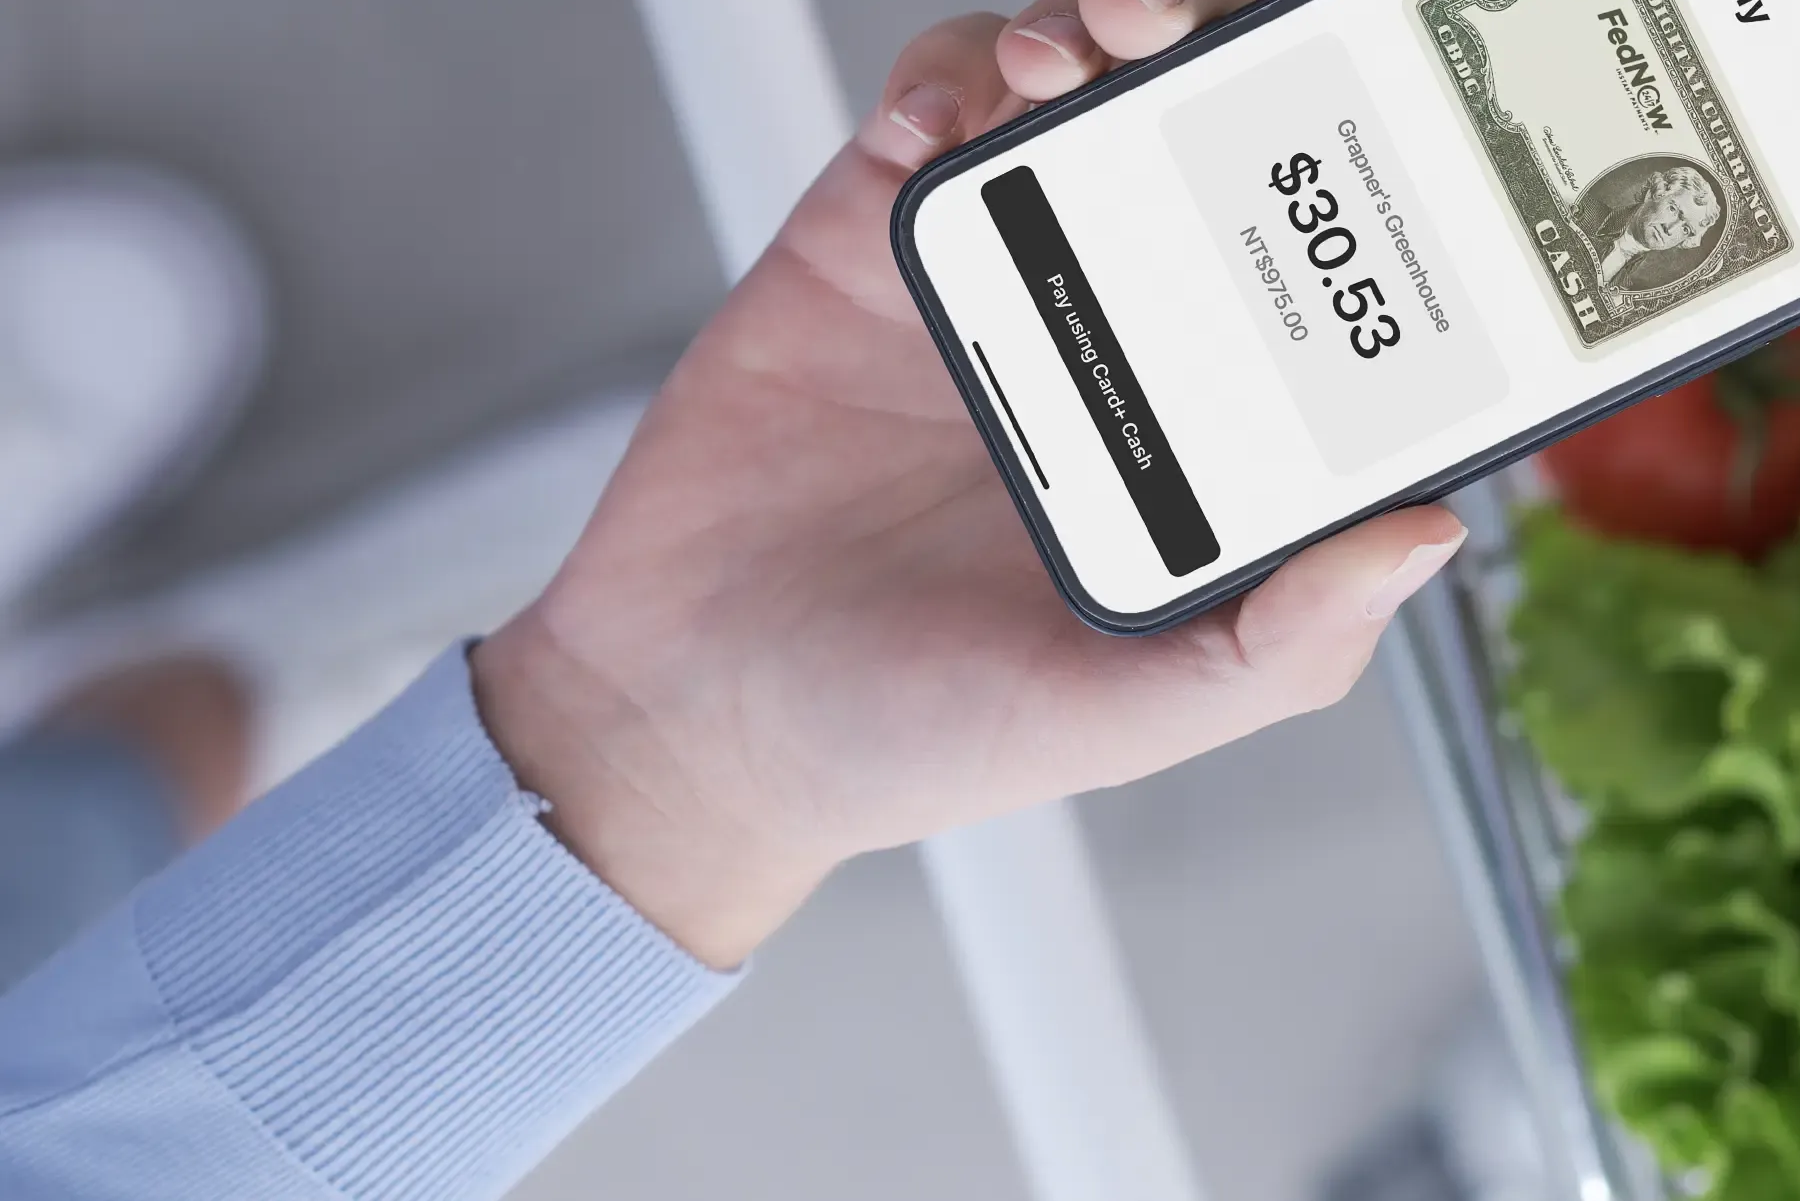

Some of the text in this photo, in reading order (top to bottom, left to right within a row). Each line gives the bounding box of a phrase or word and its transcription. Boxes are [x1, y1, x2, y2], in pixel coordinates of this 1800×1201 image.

[1438, 24, 1480, 96] CBDC
[1616, 68, 1650, 132] INSTANT PAYMENTS
[1337, 119, 1450, 333] Grapner's Greenhouse
[1701, 101, 1781, 244] CURRENCY
[1239, 225, 1308, 341] NT$975.00
[1268, 152, 1401, 359] $30.53
[1536, 219, 1602, 331] CASH
[1575, 228, 1602, 275] JEFFERSON
[1047, 273, 1152, 470] Pay using Card+ Cash
